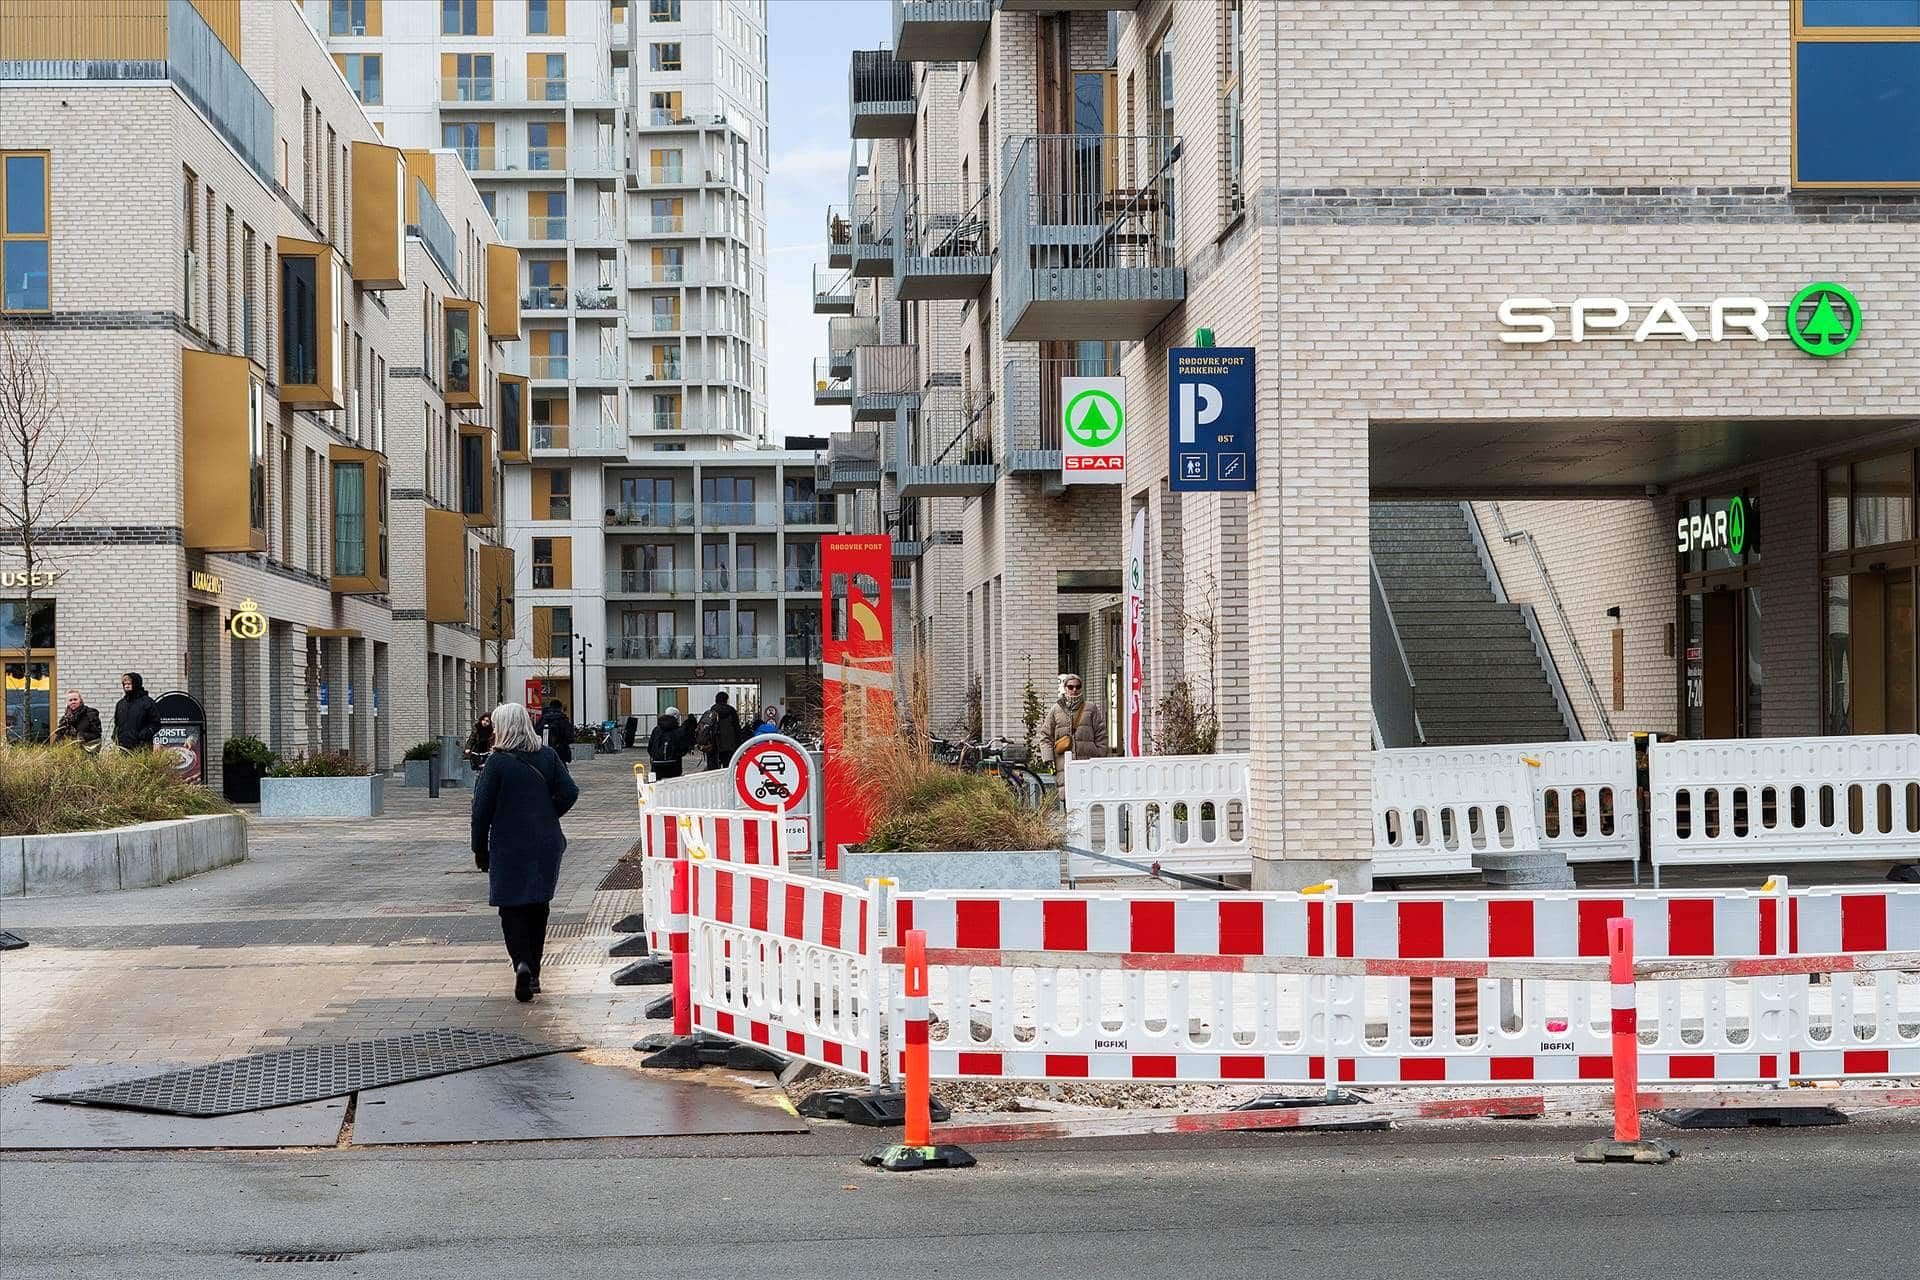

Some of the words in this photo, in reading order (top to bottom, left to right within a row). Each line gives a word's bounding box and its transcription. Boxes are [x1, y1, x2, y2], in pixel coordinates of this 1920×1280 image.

[1498, 297, 1769, 343] SPAR
[1179, 357, 1219, 365] RØDOVRE
[1222, 357, 1244, 365] PORT
[1180, 383, 1223, 443] P
[1217, 435, 1234, 443] ØST
[1067, 457, 1122, 469] SPAR
[1678, 510, 1727, 552] SPAR
[864, 543, 882, 551] PORT
[158, 729, 187, 737] ØRSTE
